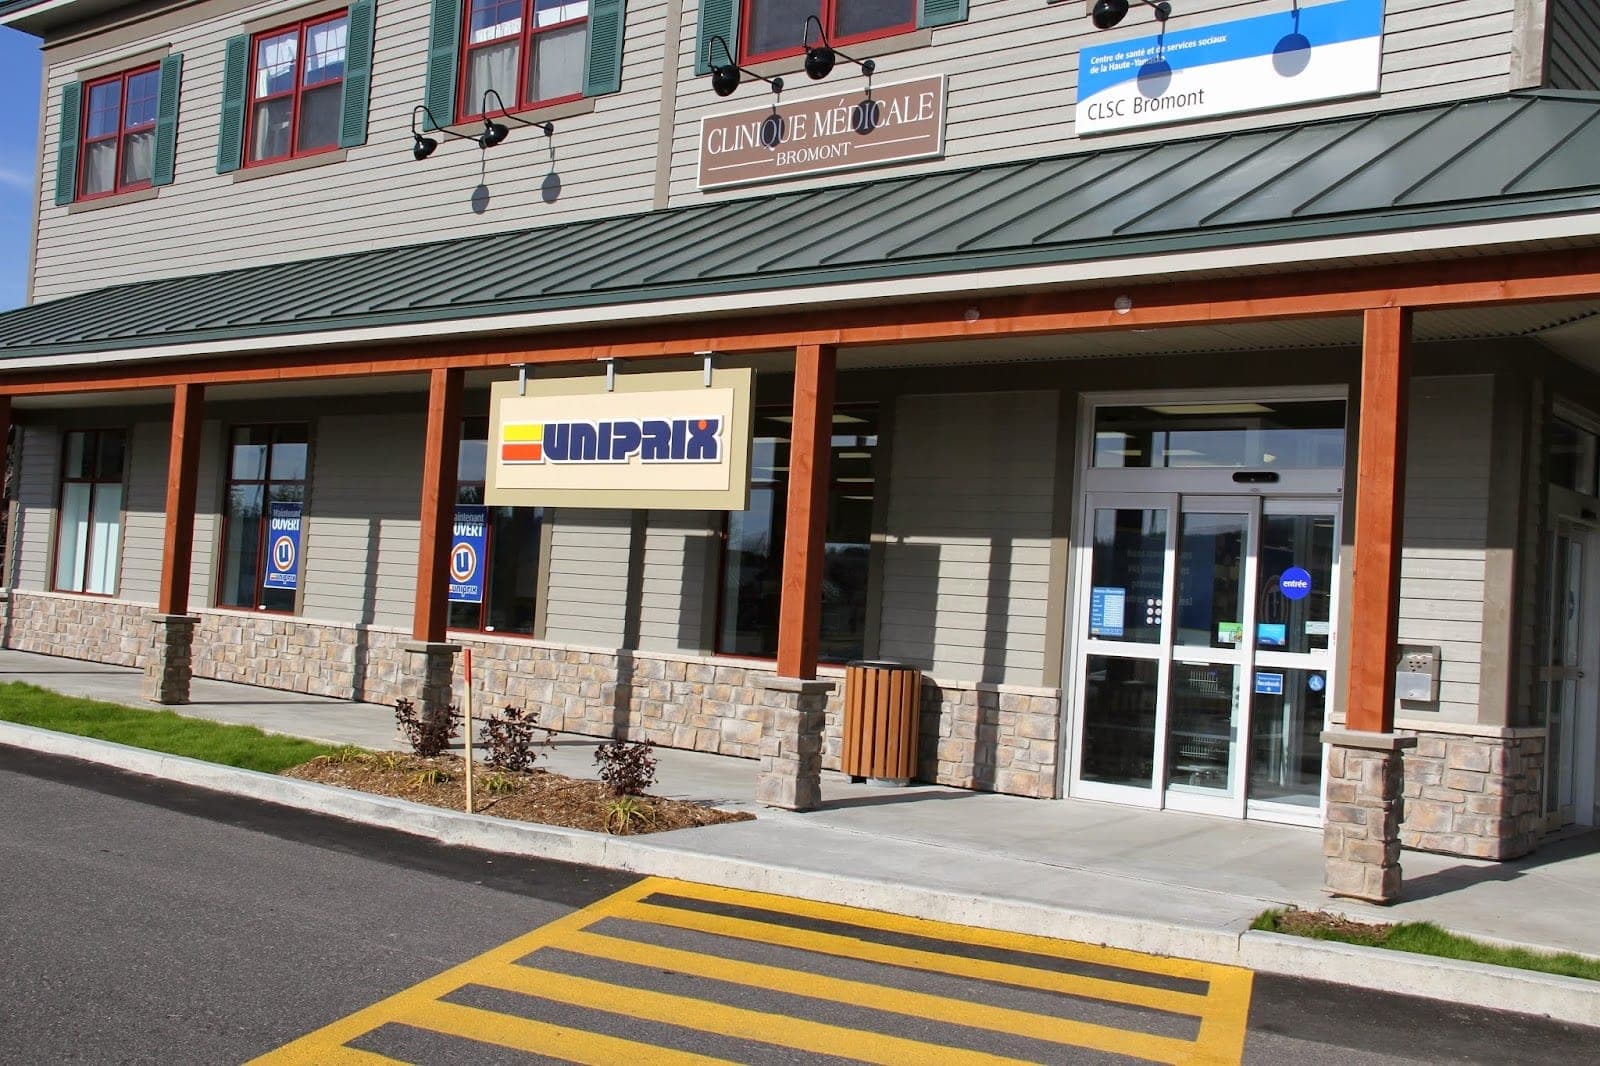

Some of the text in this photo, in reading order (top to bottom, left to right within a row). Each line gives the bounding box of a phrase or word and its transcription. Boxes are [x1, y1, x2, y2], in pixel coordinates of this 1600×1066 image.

[1090, 35, 1228, 65] Centre de santé et de services sociaux
[1090, 65, 1100, 74] de
[1100, 62, 1108, 72] la
[1088, 88, 1205, 121] CLSC Bromont
[708, 92, 935, 154] CLINIQUE MÉDICALE
[776, 141, 852, 166] BROMONT
[543, 419, 720, 461] UNIPRIX
[272, 518, 301, 531] OUVERT
[453, 511, 485, 522] aintenant
[453, 523, 484, 537] UVERT
[1283, 580, 1308, 588] entrée
